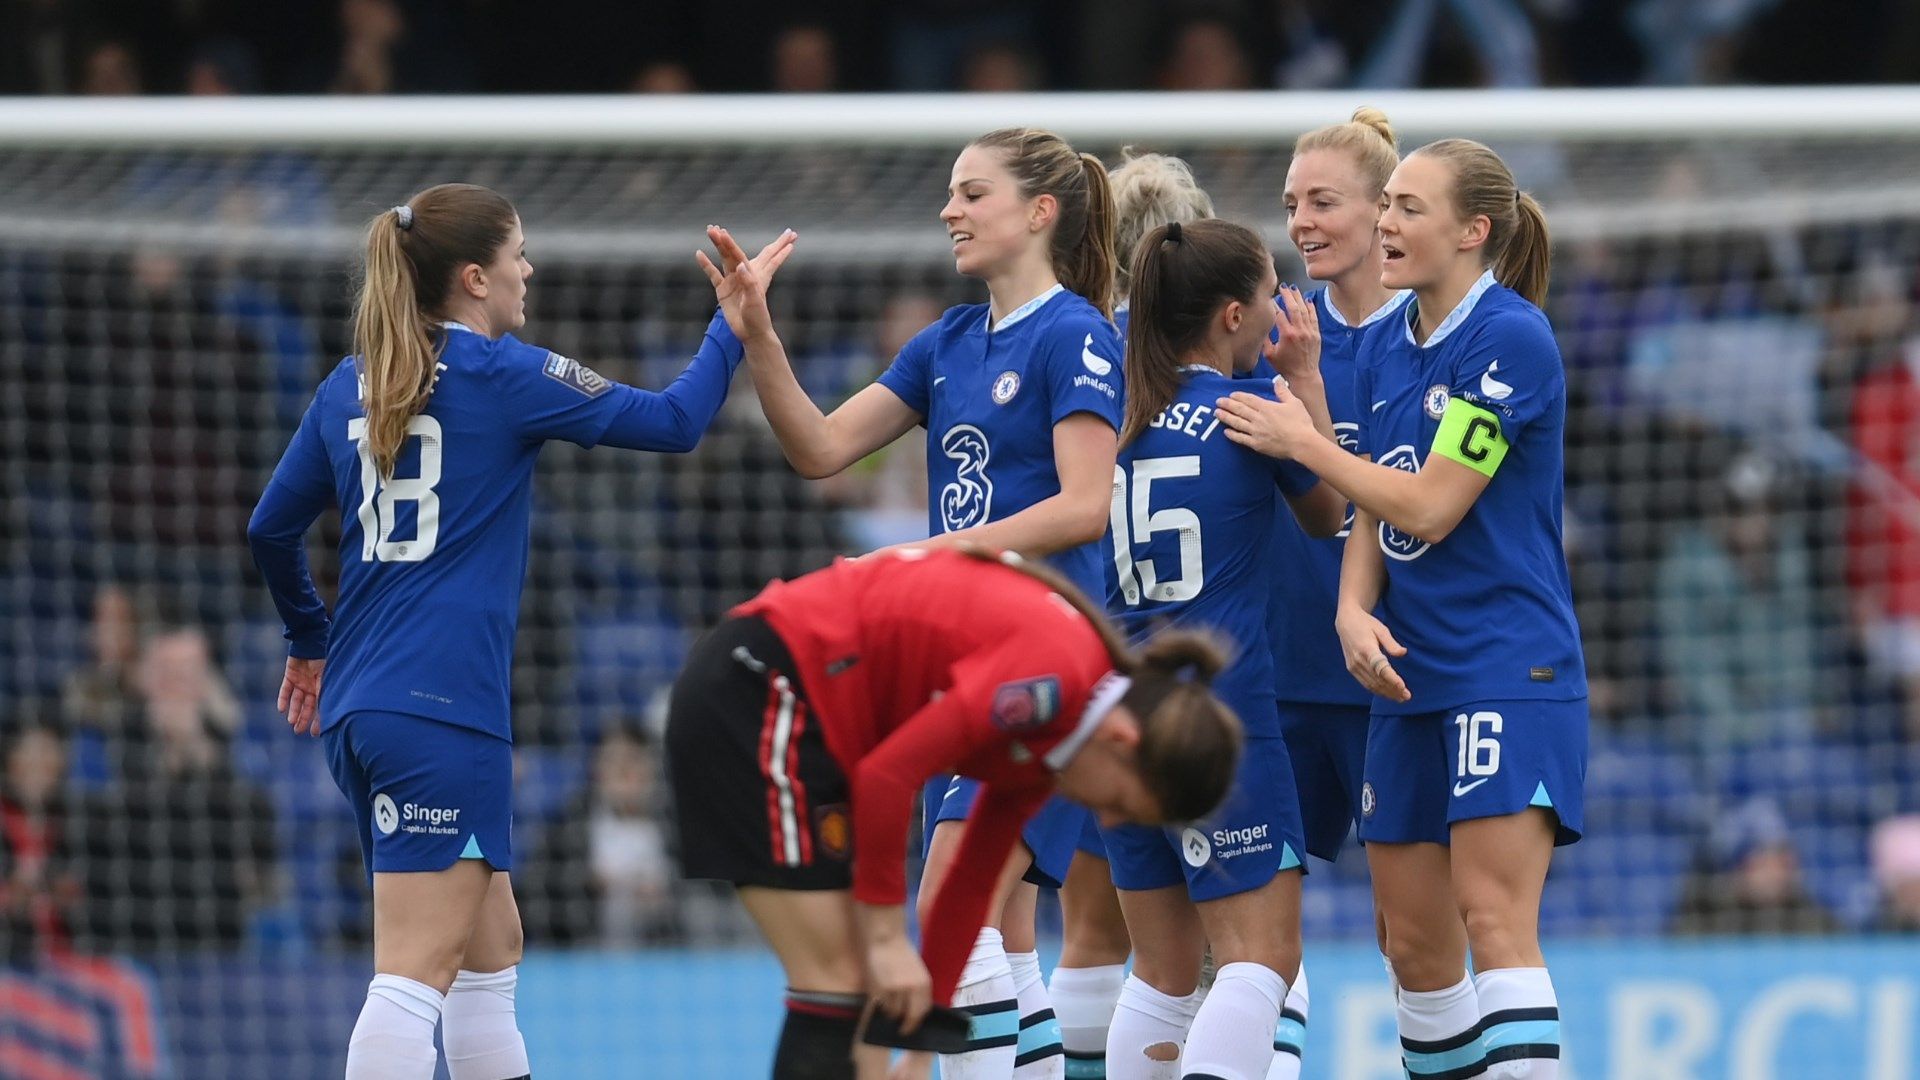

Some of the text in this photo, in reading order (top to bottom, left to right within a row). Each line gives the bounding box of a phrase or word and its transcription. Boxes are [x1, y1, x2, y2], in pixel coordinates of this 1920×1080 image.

[1073, 374, 1116, 399] WhaleFin
[1459, 416, 1499, 462] C
[348, 414, 443, 562] 18
[1110, 455, 1203, 605] 15
[1454, 711, 1503, 777] 16
[403, 803, 460, 825] Singer
[401, 824, 459, 835] Capital Markets
[1213, 823, 1268, 847] Singer
[1216, 842, 1273, 859] Capital Markets
